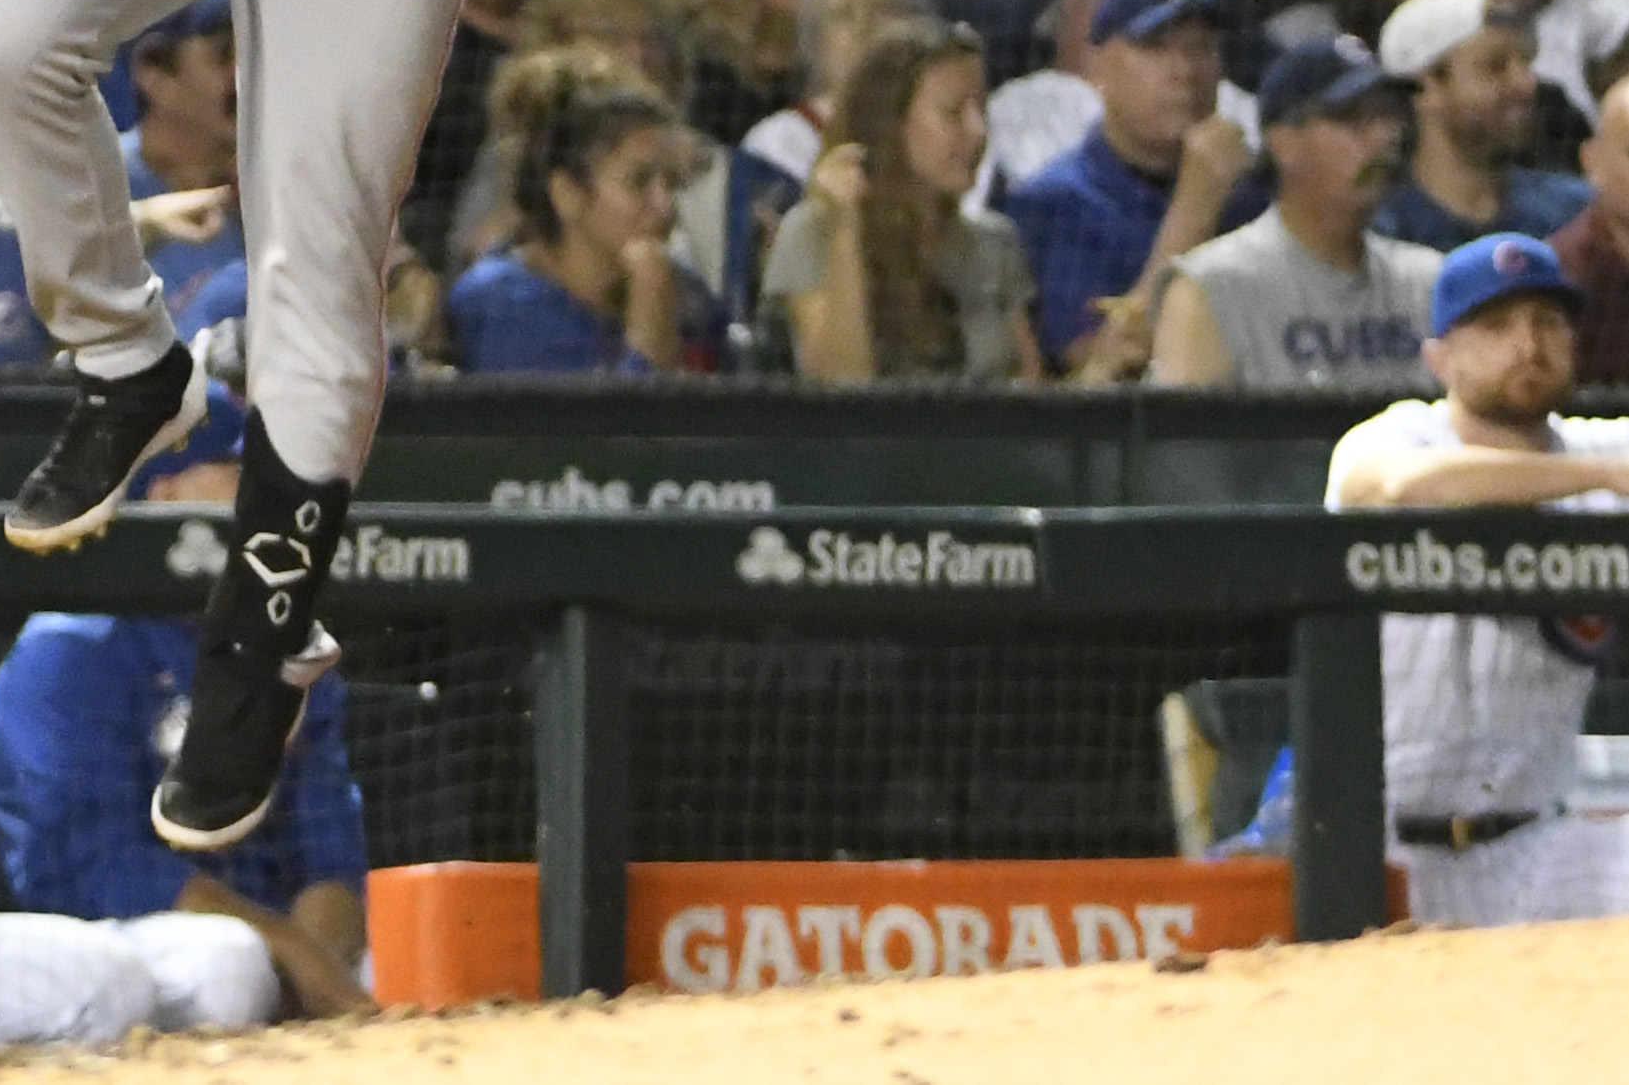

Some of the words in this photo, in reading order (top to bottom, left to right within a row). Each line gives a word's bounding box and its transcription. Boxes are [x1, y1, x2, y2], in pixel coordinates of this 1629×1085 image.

[806, 528, 1036, 585] StateFarm
[1345, 528, 1629, 592] cubs.com
[660, 904, 1194, 994] GATORADE
